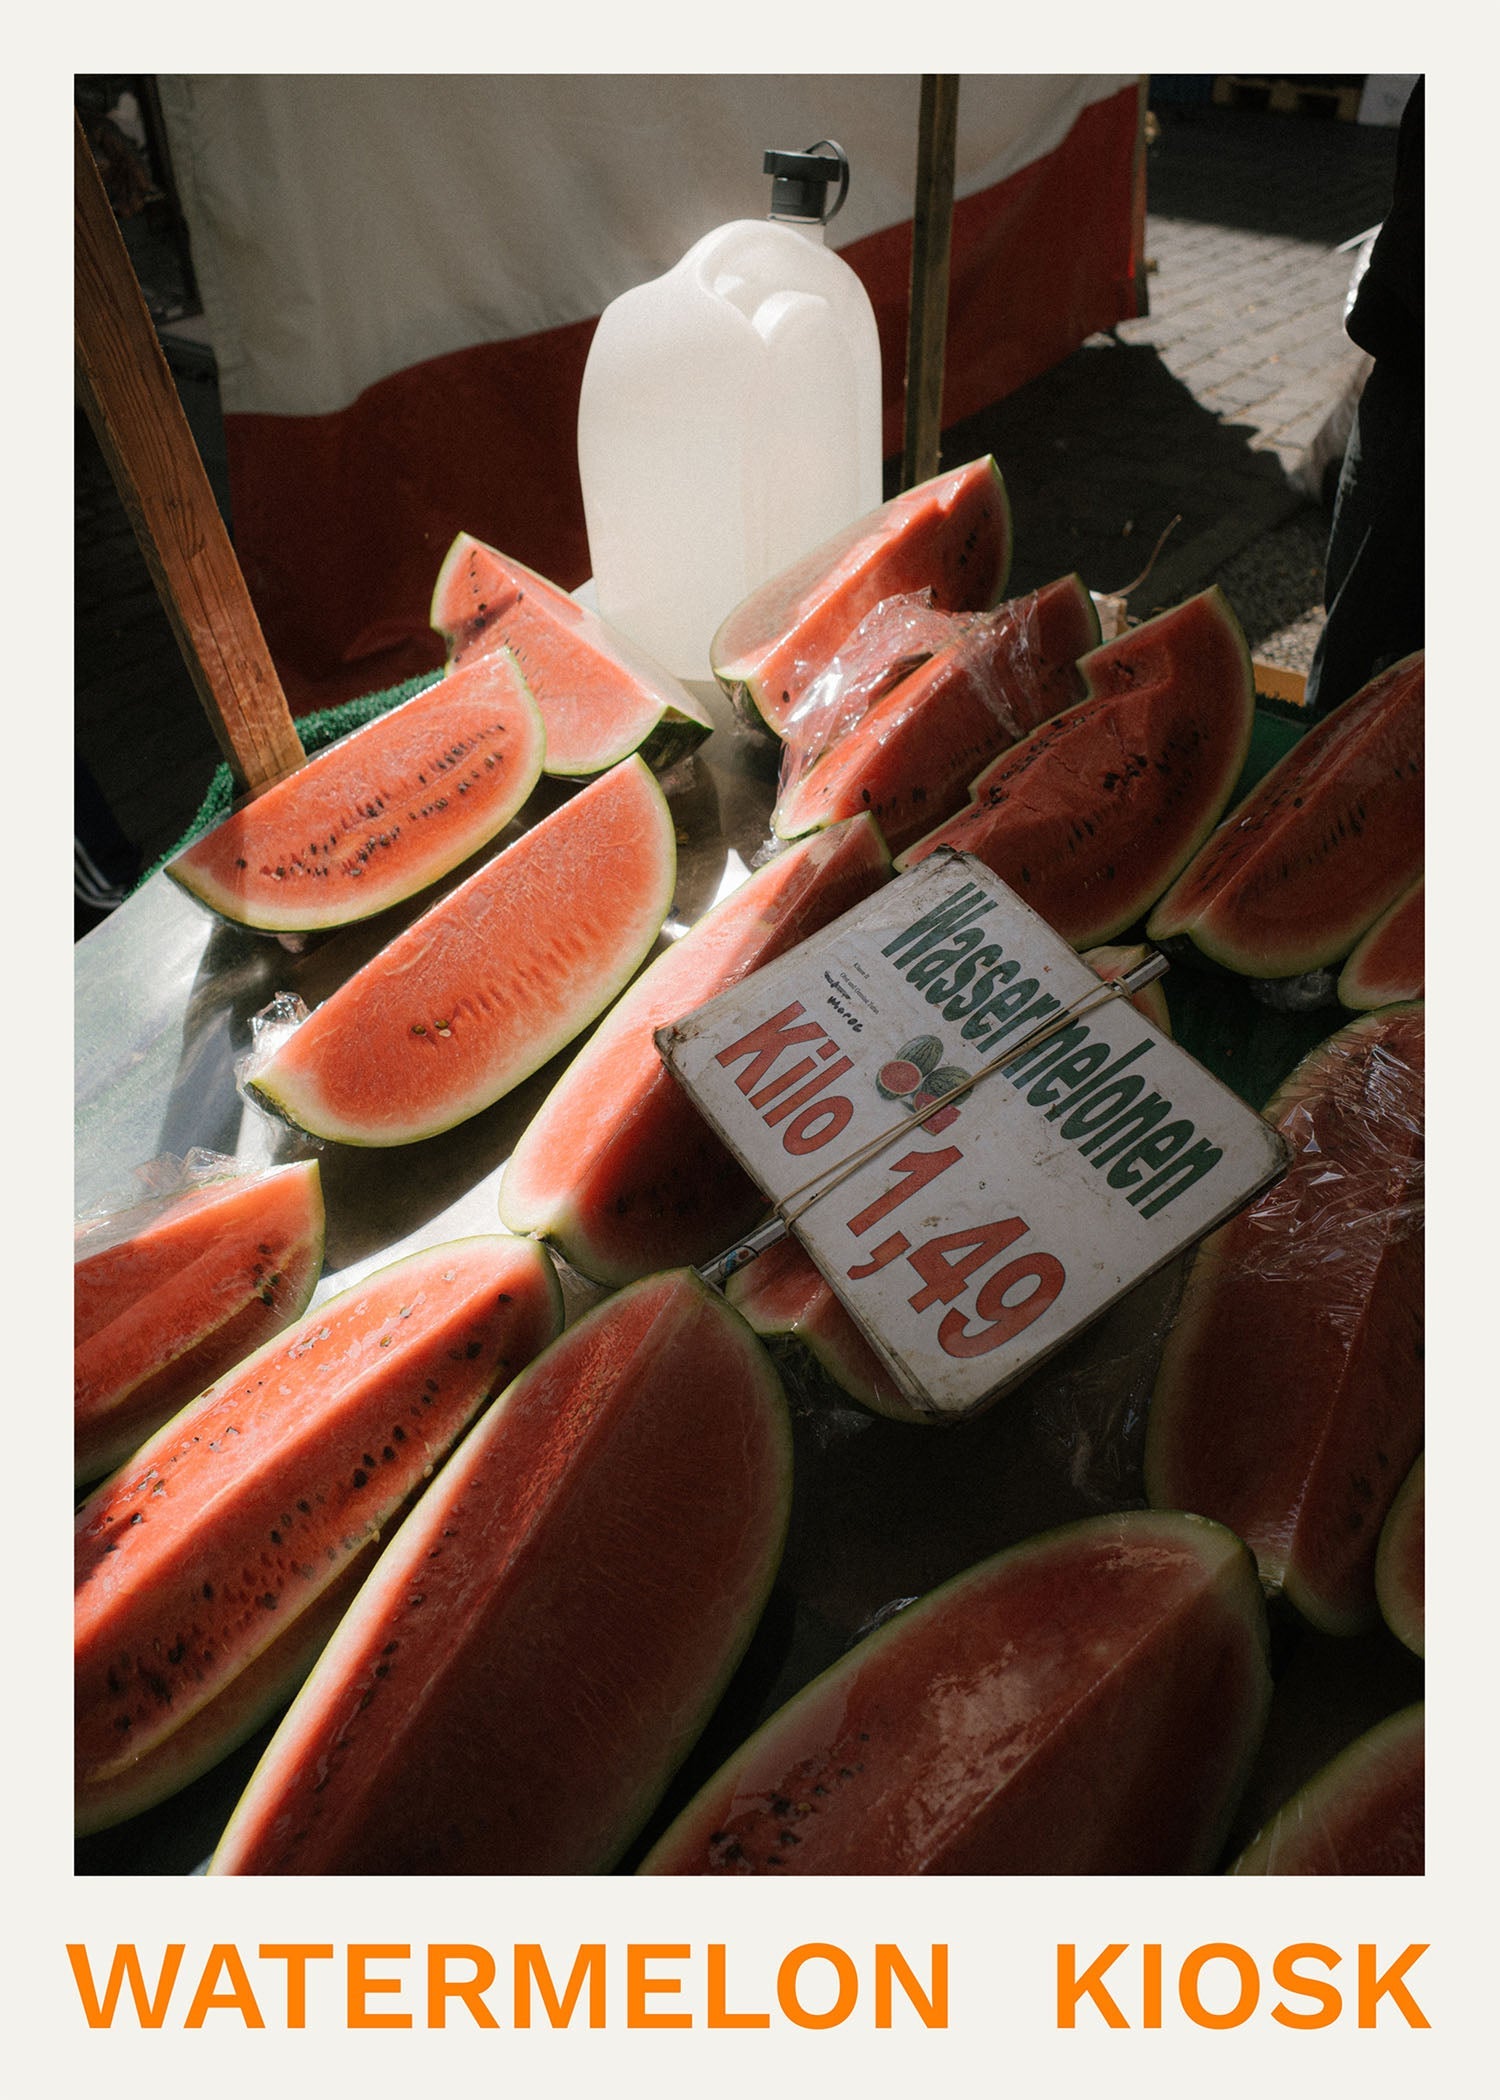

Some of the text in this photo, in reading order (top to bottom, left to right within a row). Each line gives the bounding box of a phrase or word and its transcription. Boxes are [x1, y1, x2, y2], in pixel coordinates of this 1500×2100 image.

[714, 1000, 854, 1156] Kilo
[880, 881, 1224, 1220] Wassermelonen
[845, 1143, 1067, 1359] 1,49
